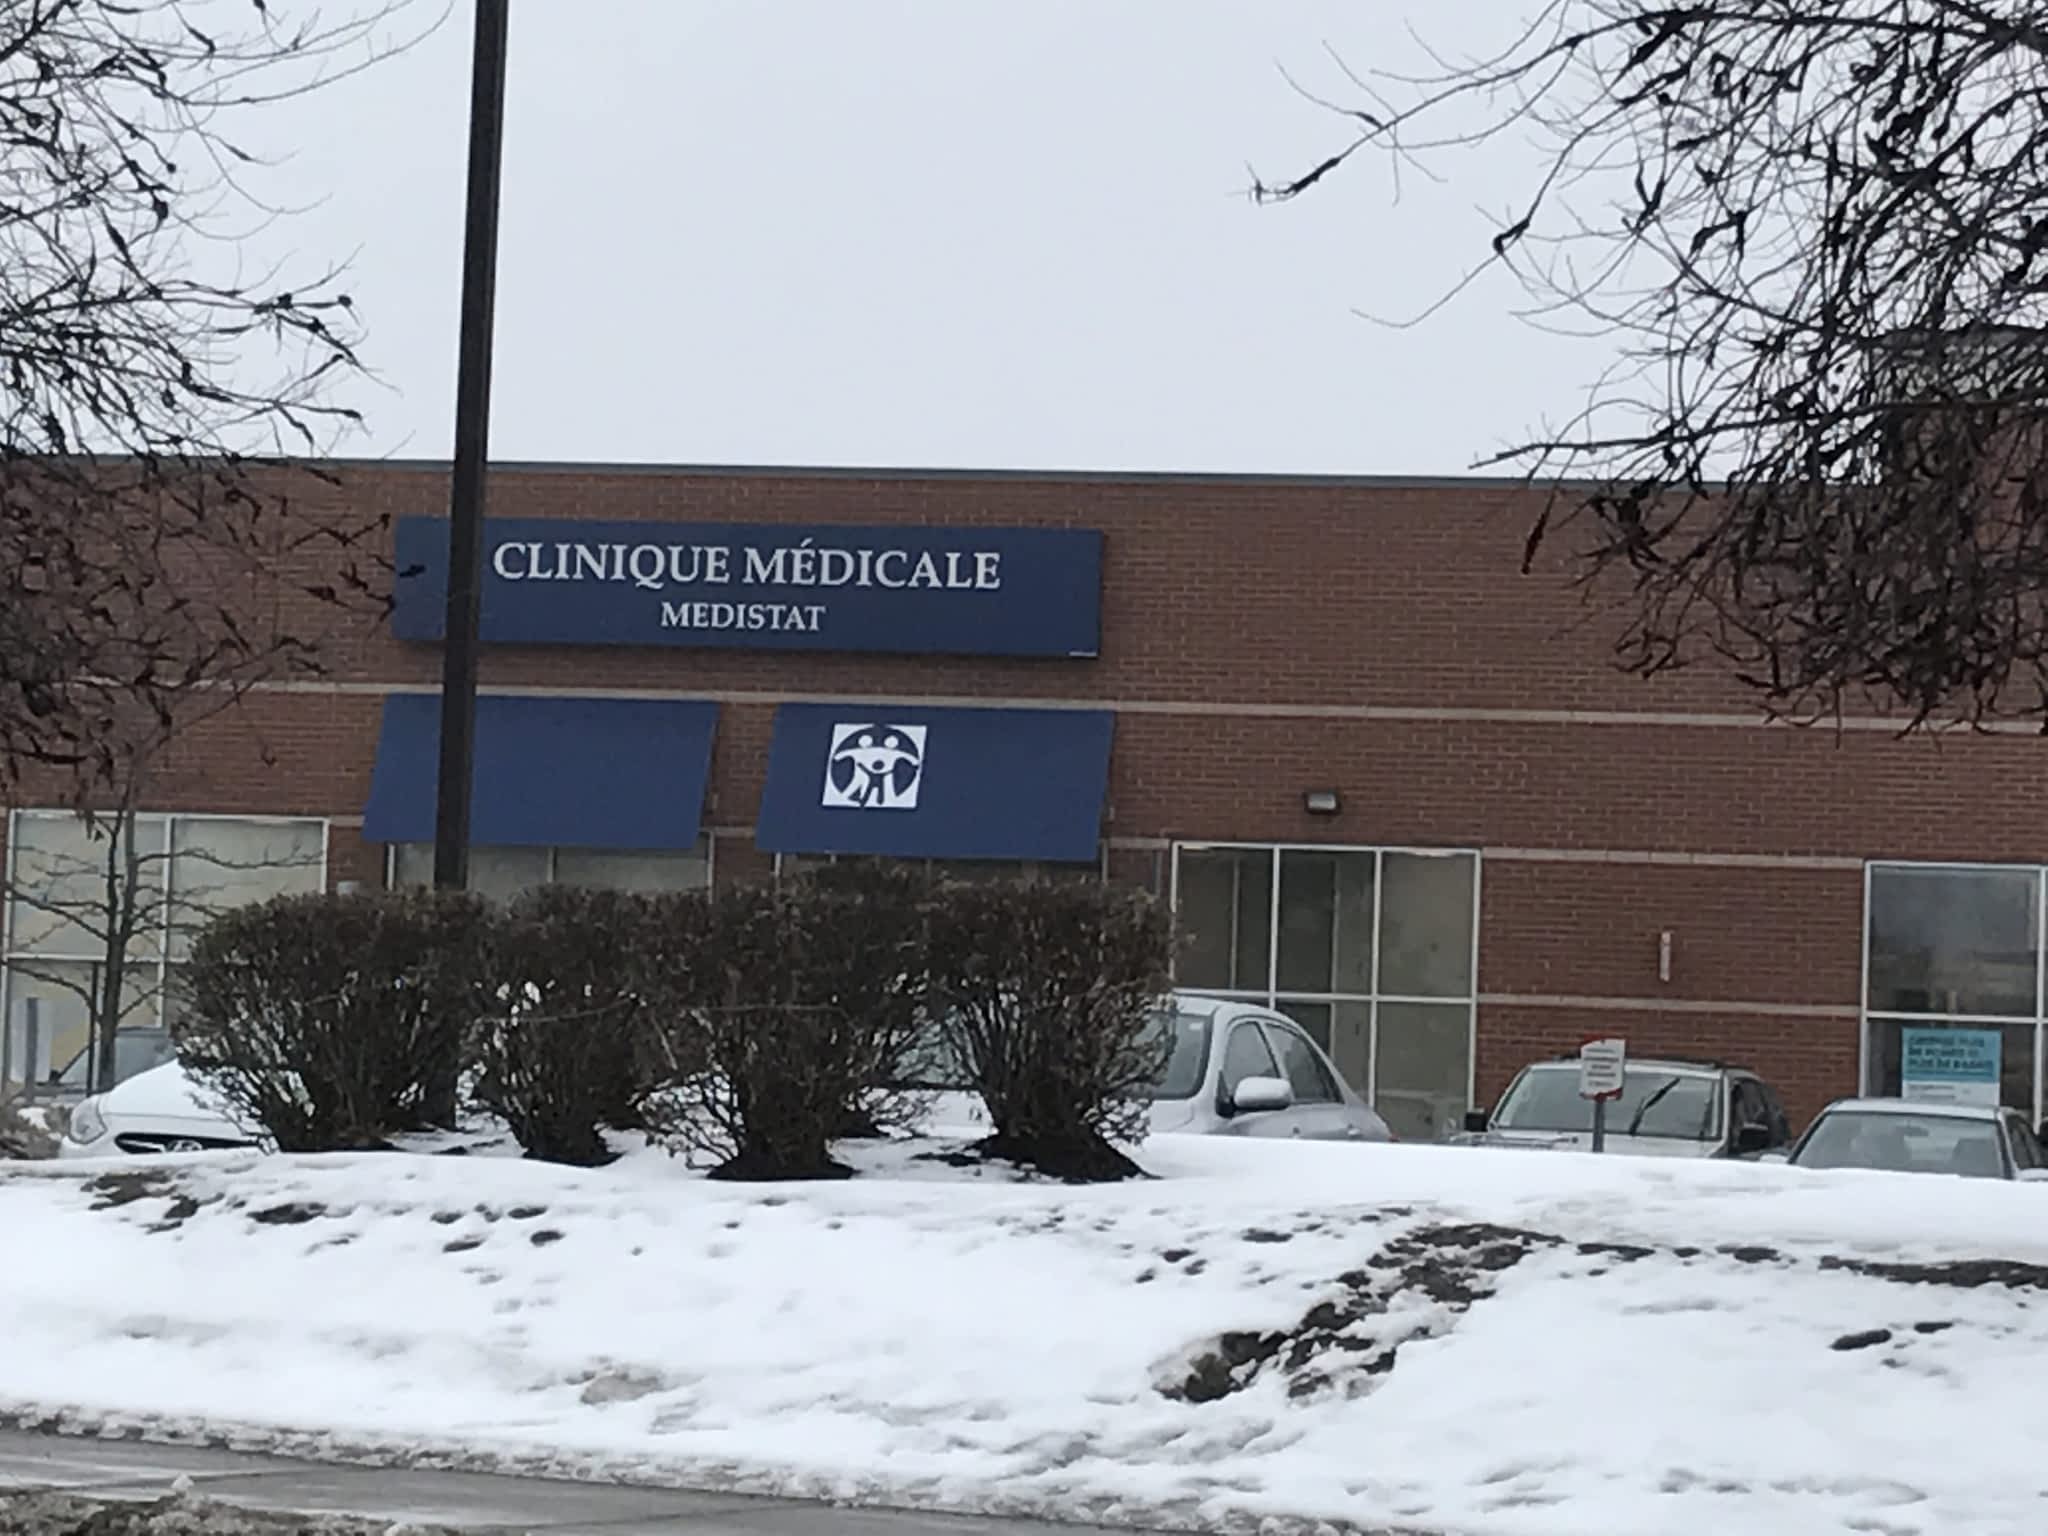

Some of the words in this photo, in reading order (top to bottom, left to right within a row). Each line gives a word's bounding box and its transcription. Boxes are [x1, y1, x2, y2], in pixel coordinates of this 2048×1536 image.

[493, 541, 731, 590] CLINIQUE
[742, 537, 1002, 590] MÉDICALE
[660, 601, 827, 632] MEDISTAT
